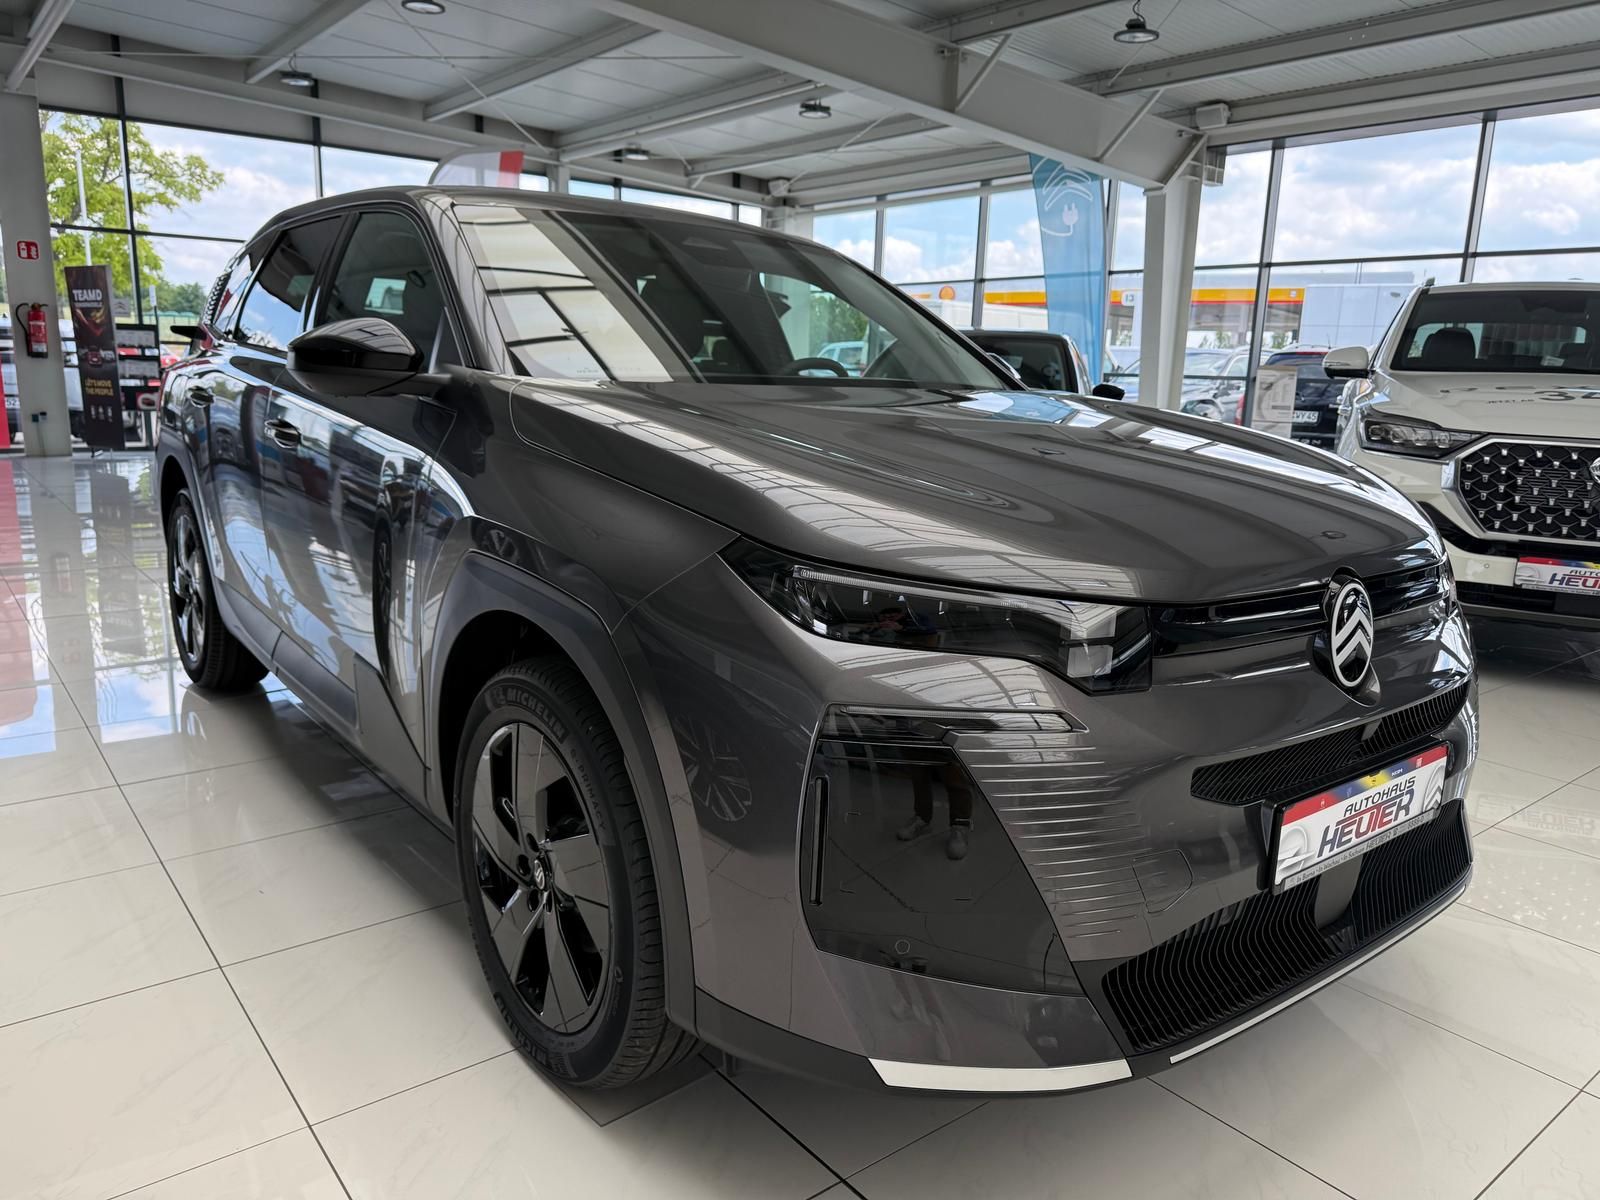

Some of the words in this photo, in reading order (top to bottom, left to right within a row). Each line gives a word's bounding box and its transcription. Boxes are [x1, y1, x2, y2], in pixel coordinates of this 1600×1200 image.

[1548, 572, 1600, 590] HEU
[506, 687, 566, 742] MICHELIN
[1343, 776, 1416, 817] AUTOHAUS
[1317, 788, 1415, 858] HEUTER
